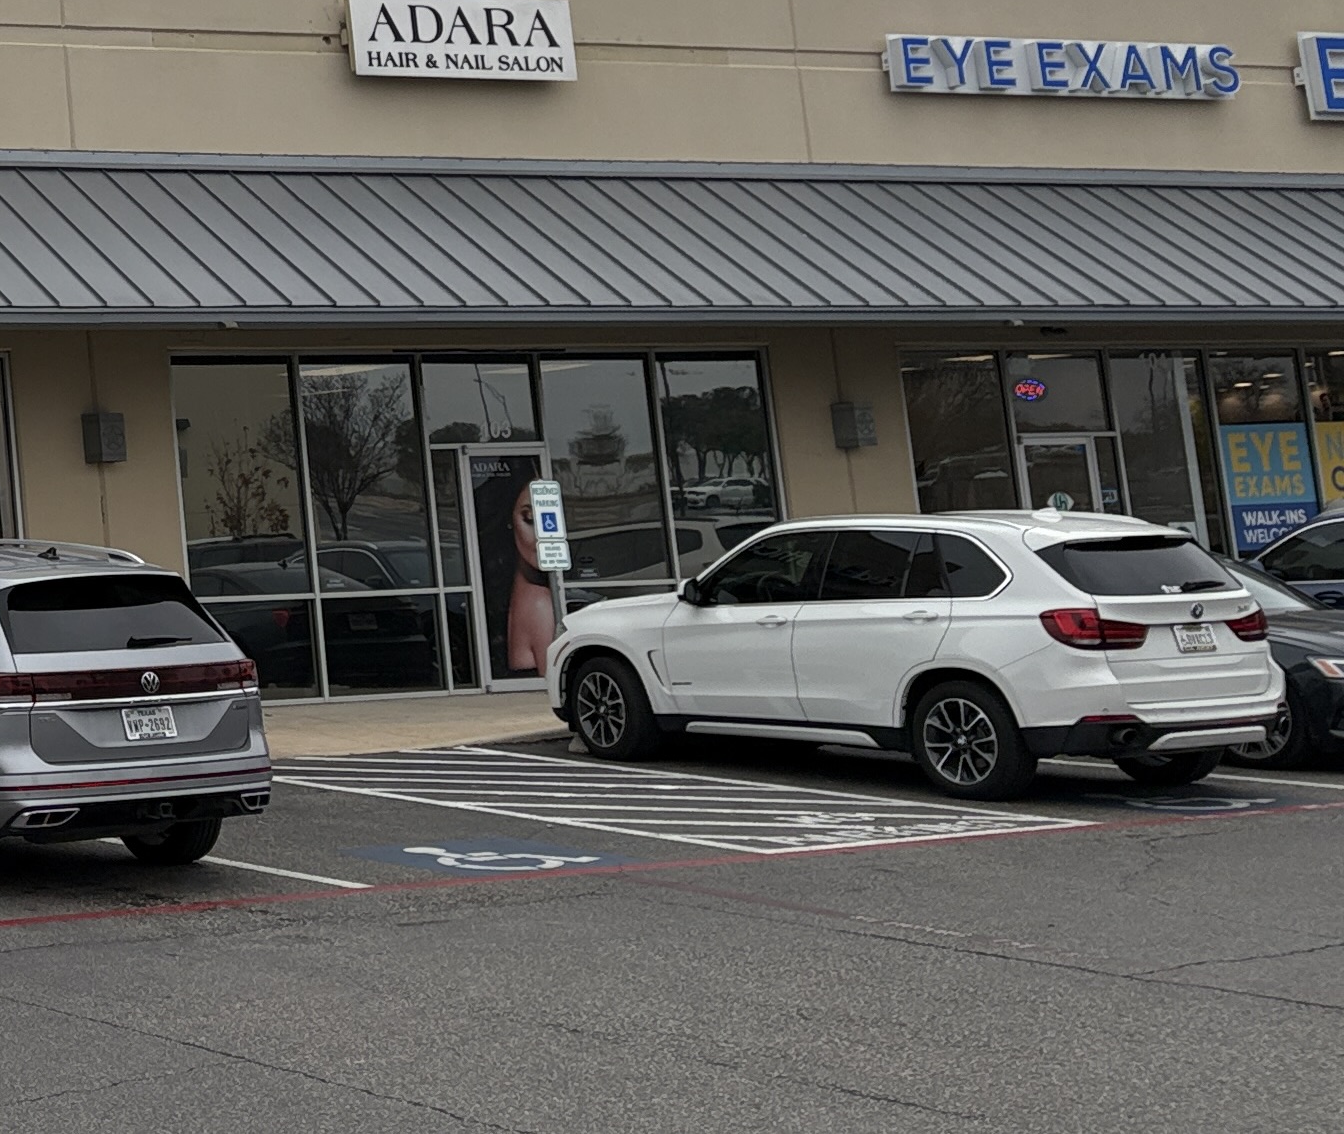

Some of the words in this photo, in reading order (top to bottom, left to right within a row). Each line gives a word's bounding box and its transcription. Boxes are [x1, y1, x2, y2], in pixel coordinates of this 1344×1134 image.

[368, 3, 560, 48] ADARA
[366, 51, 417, 69] HAIR
[425, 53, 439, 69] &
[445, 53, 493, 71] NAIL
[498, 55, 564, 73] SALON
[897, 37, 1017, 90] EYE
[1029, 41, 1241, 96] EXAMS
[1014, 383, 1046, 397] OPEN
[1227, 431, 1302, 473] EYE
[473, 461, 510, 472] ADARA
[1234, 474, 1305, 498] EXAMS
[1242, 508, 1308, 527] WALK-INS
